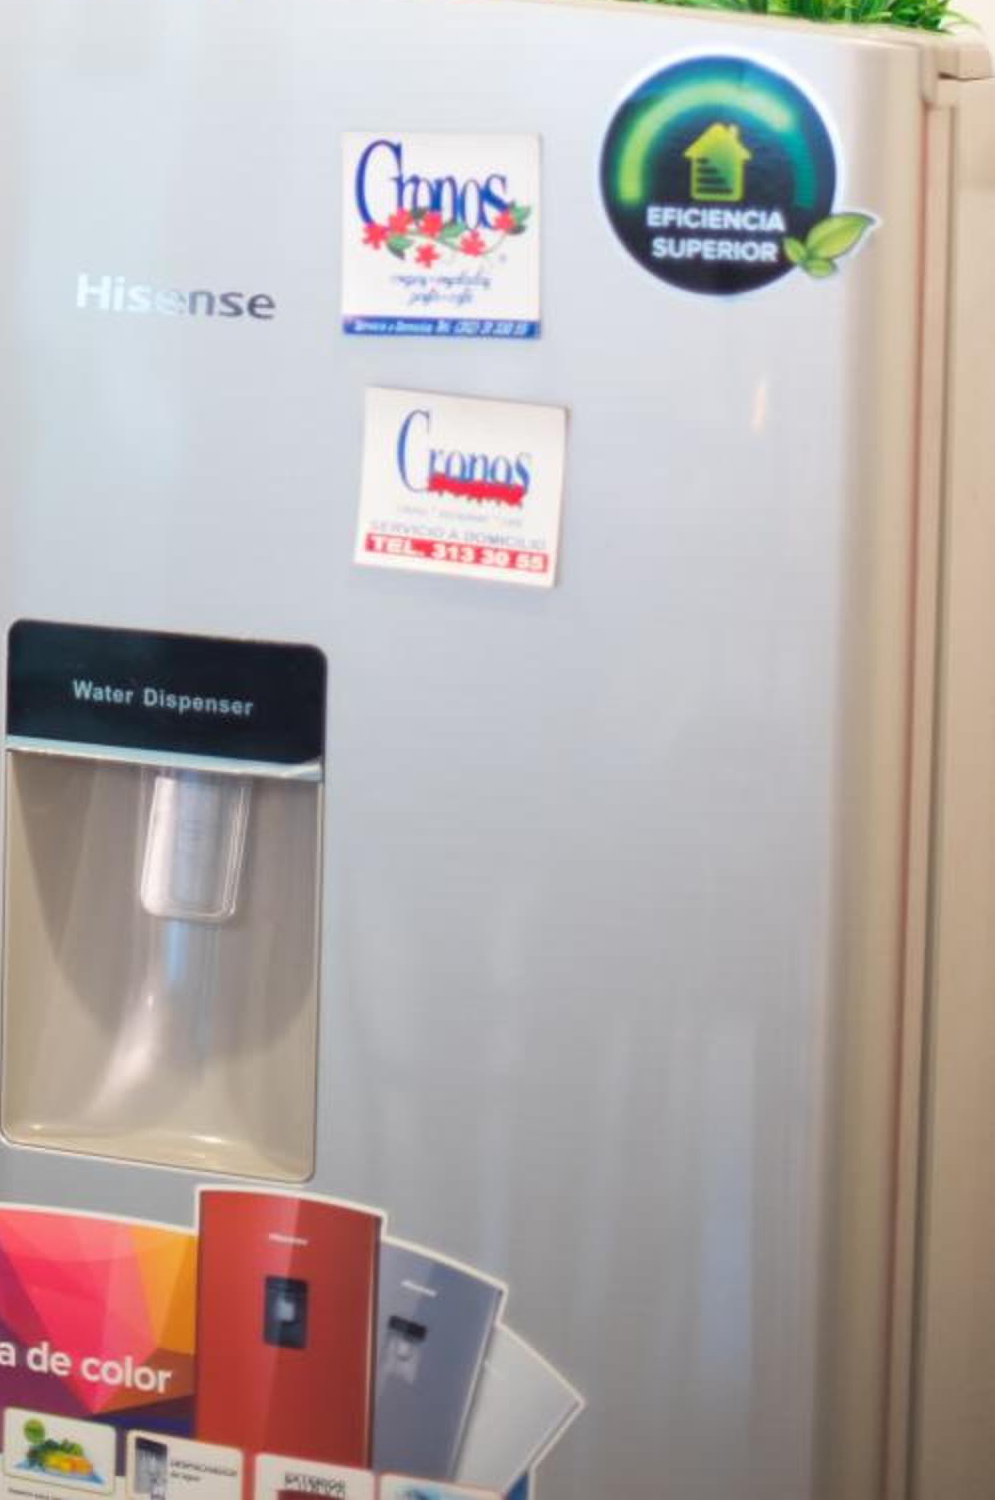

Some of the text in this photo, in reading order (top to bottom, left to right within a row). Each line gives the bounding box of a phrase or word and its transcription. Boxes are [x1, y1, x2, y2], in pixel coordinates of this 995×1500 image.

[646, 205, 786, 232] EFICIENCIA
[652, 237, 779, 262] SUPERIOR
[76, 273, 276, 320] Hisense
[396, 408, 531, 495] Cronos
[431, 541, 476, 564] 313
[73, 678, 254, 716] Water Dispenser
[26, 1341, 72, 1377] de
[80, 1355, 174, 1394] color
